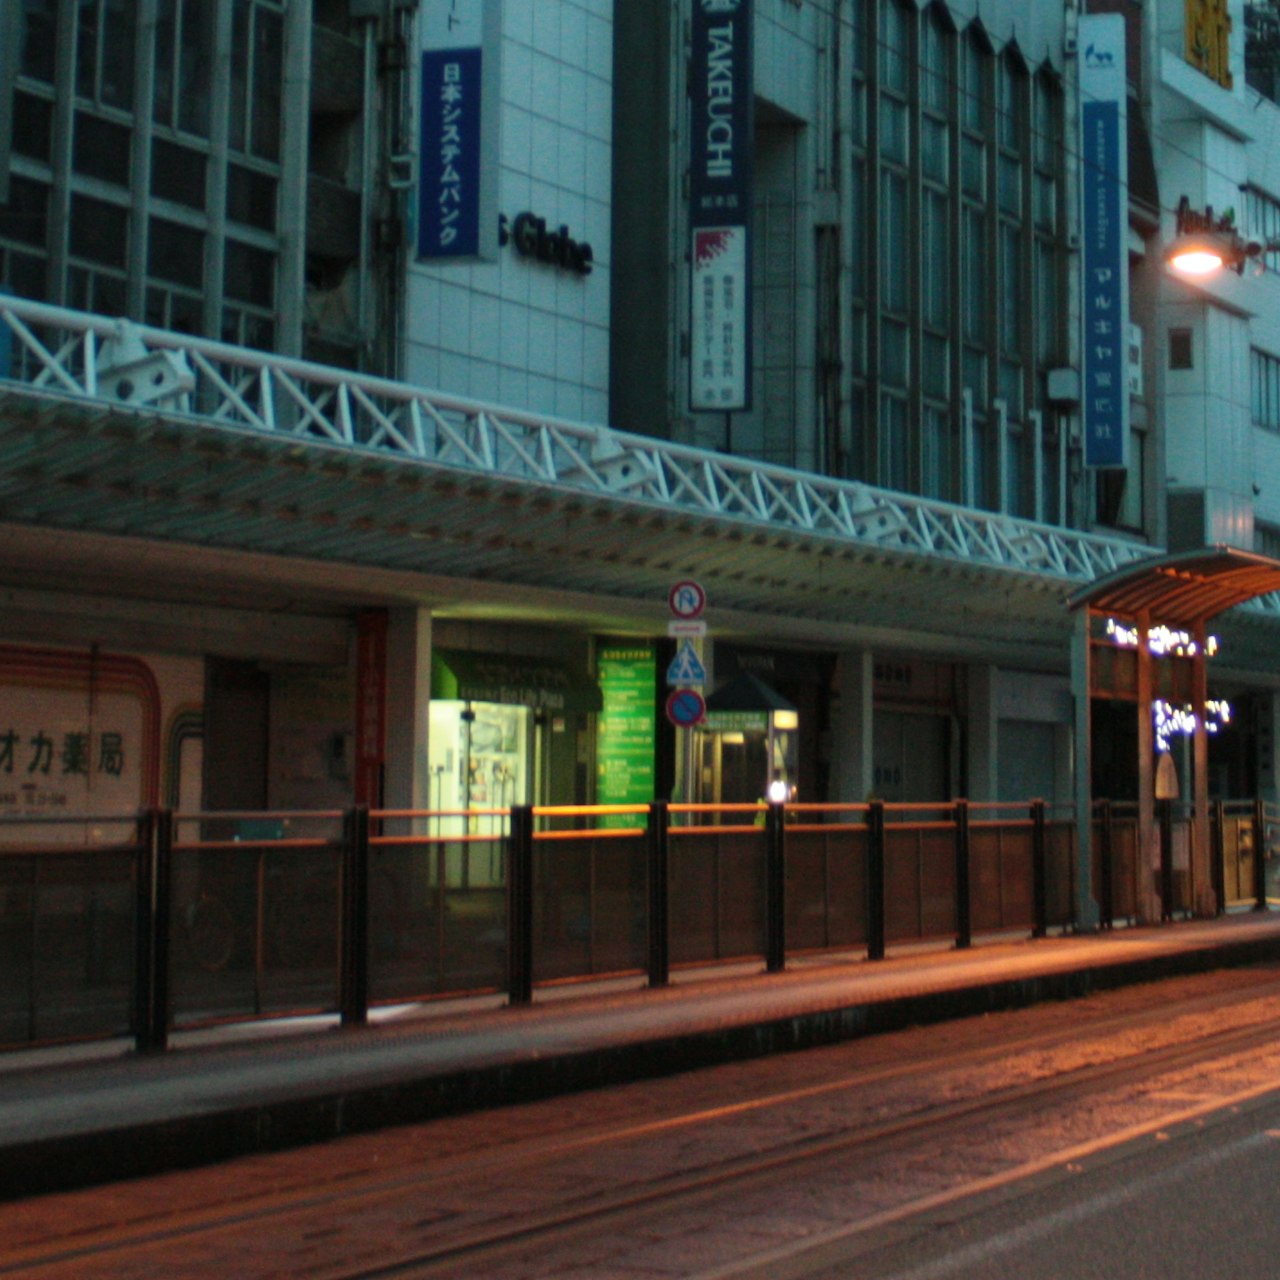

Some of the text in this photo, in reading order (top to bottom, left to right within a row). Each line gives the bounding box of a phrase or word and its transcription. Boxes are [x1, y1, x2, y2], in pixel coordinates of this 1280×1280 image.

[439, 62, 462, 247] 日本システムバンク
[705, 20, 735, 178] TAKEUCHI
[512, 211, 593, 277] Globe
